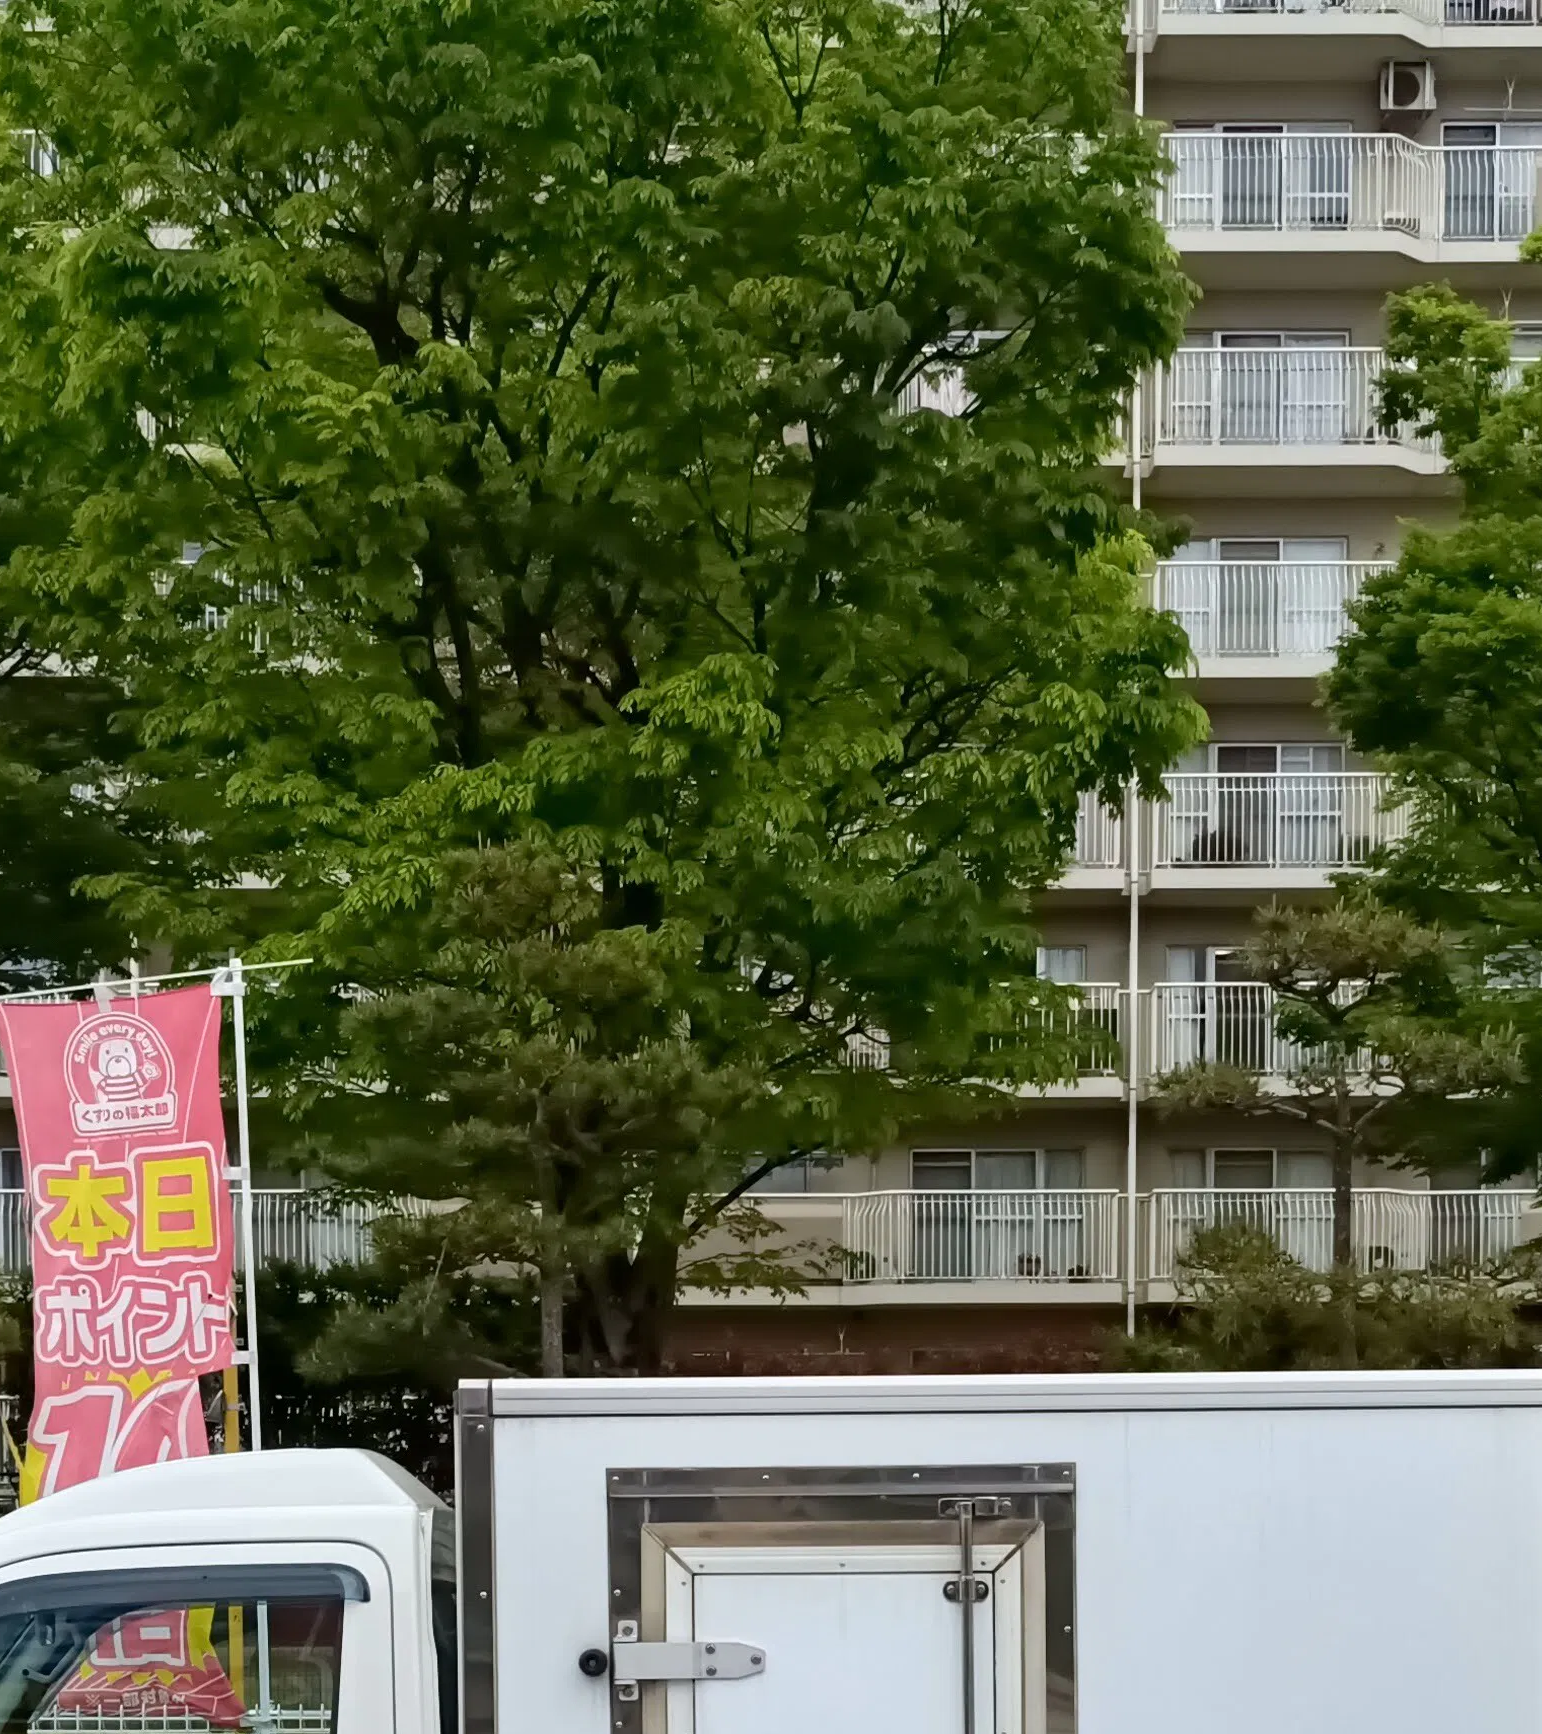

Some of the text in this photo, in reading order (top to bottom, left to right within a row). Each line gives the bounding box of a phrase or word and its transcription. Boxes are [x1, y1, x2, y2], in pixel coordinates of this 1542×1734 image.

[74, 1031, 99, 1065] Smile
[99, 1023, 136, 1040] every
[80, 1102, 169, 1124] くすりの福太郎
[46, 1156, 215, 1258] 本日
[43, 1280, 230, 1360] ポイント
